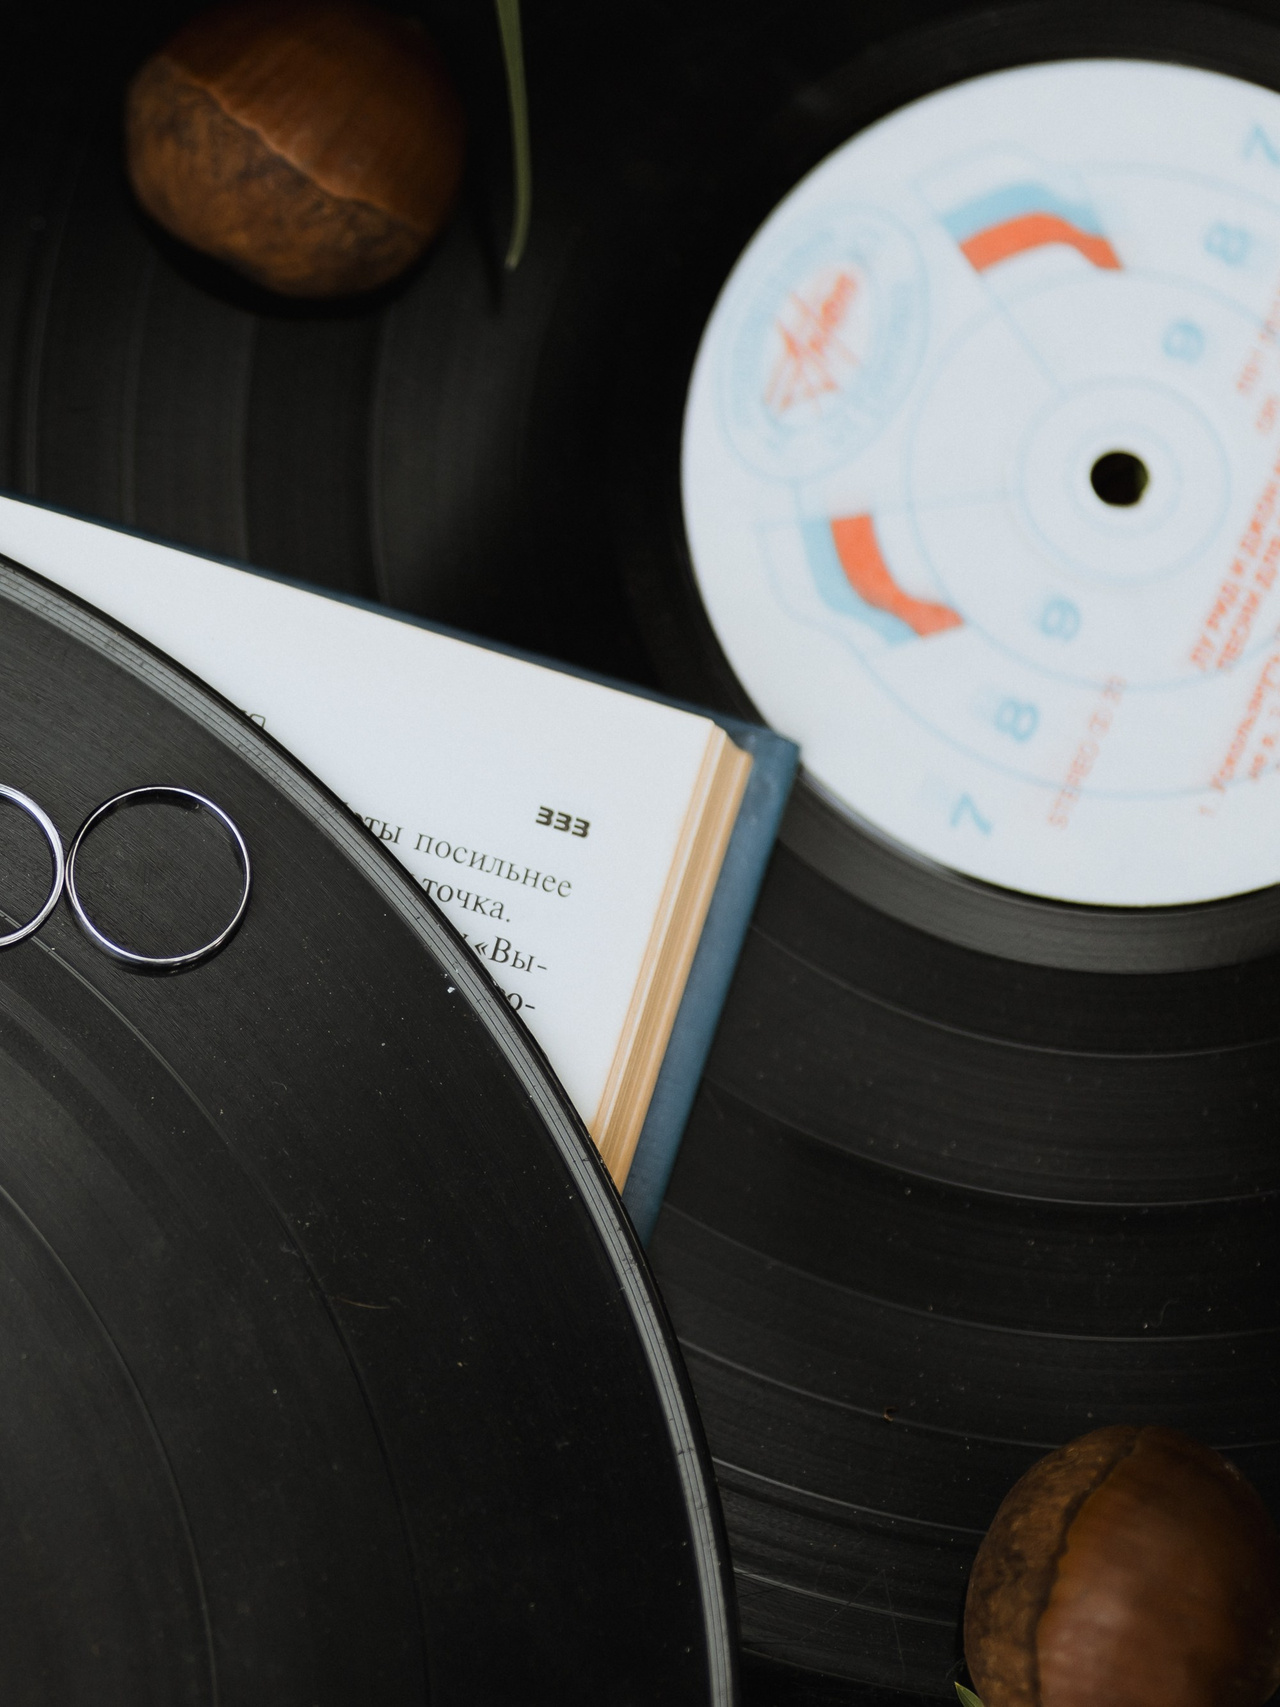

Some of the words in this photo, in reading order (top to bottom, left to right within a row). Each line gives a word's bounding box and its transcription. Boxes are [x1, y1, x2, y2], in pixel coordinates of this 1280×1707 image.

[535, 805, 590, 839] 333
[355, 812, 405, 844] ты
[413, 832, 574, 898] посильнее
[422, 877, 512, 923] точка.
[474, 935, 548, 974] «Вы-
